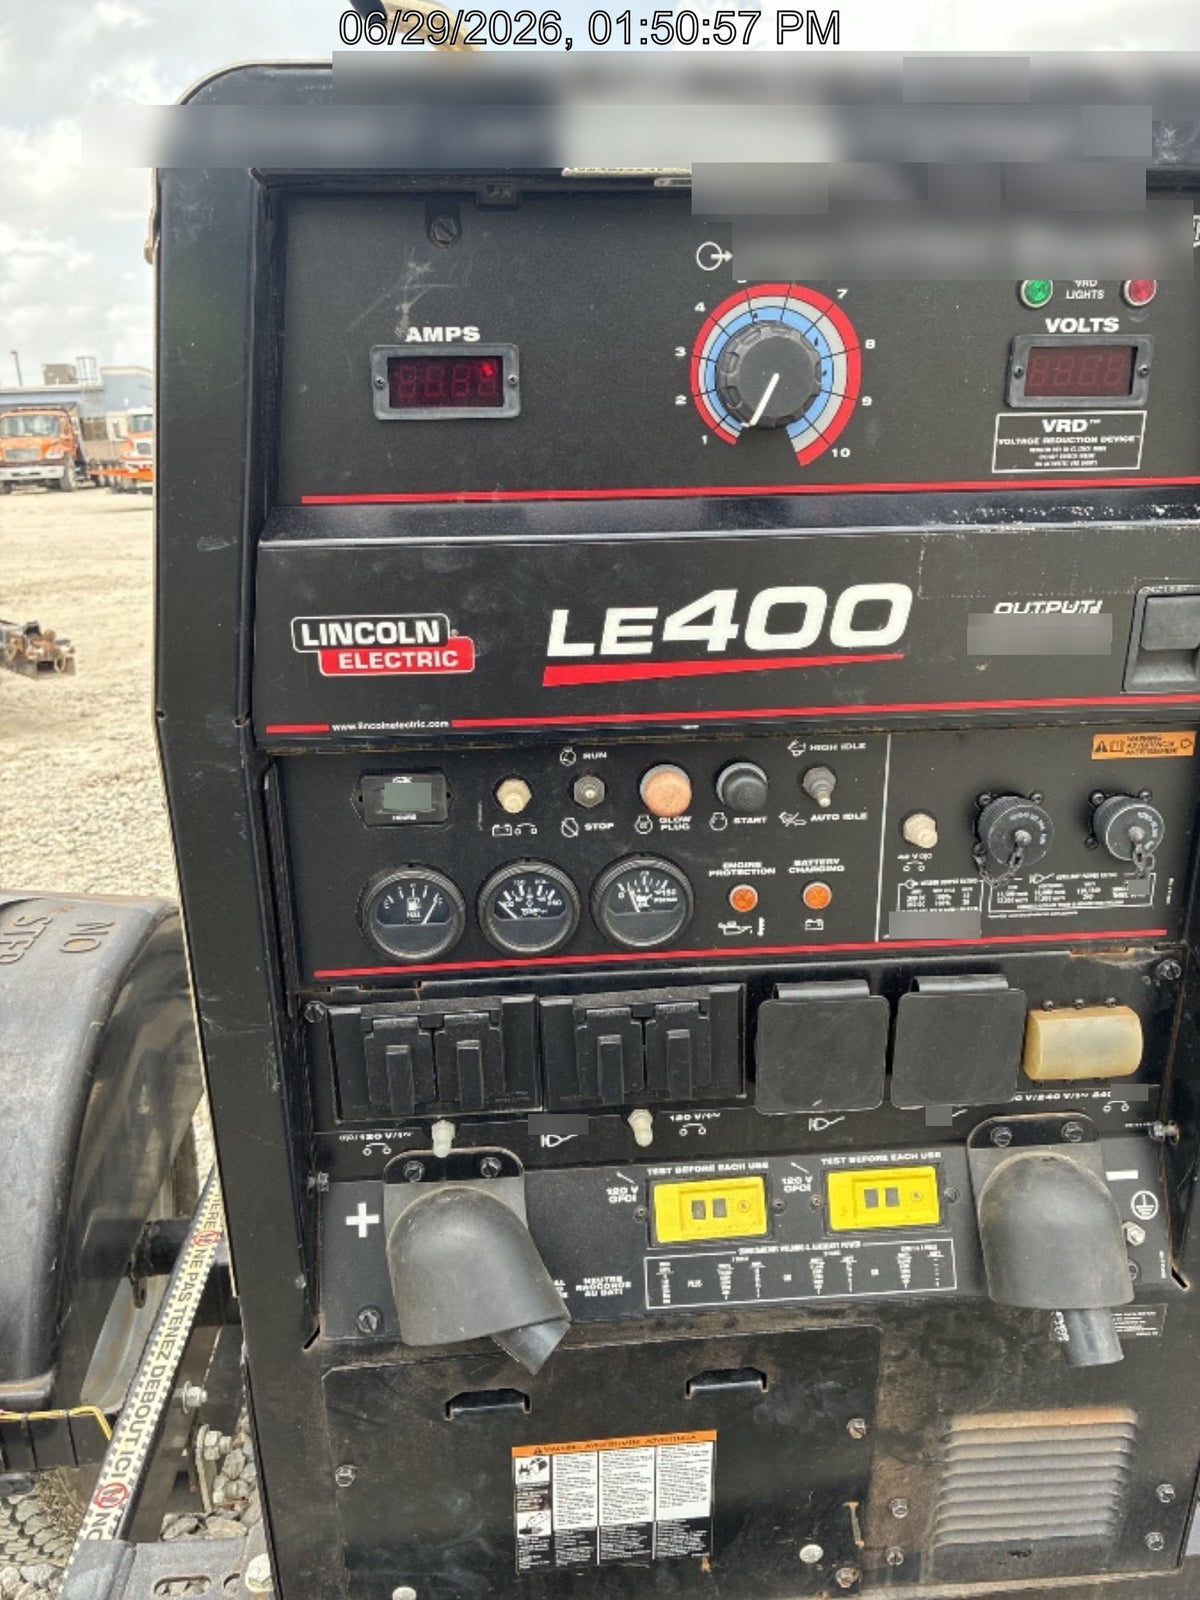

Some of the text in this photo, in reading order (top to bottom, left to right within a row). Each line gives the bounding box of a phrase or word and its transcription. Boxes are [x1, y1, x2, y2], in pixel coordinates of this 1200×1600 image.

[837, 289, 848, 298] 7
[1066, 290, 1105, 300] LIGHTS
[695, 302, 705, 312] 4
[1045, 317, 1120, 333] VOLTS
[405, 326, 480, 342] AMPS
[866, 340, 875, 349] 8
[675, 347, 686, 356] 3
[675, 396, 686, 405] 2
[862, 397, 872, 406] 9
[702, 435, 707, 444] 1
[1042, 436, 1098, 444] REDUCTION
[832, 449, 850, 458] 10
[547, 583, 913, 657] LE400
[301, 620, 440, 646] LINCOLN
[338, 651, 459, 669] ELECTRIC
[332, 721, 449, 731] www.lincolnelectric.com
[810, 743, 837, 751] HIGH
[733, 816, 767, 824] START
[810, 814, 840, 822] AUTO
[709, 868, 776, 877] PROTECTION
[788, 865, 845, 873] CHARGING
[821, 1151, 942, 1165] TEST BEFORE EACH USE
[647, 1161, 769, 1176] TEST BEFORE EACH USE
[805, 1176, 813, 1184] V
[606, 1185, 639, 1195] 120 V
[608, 1194, 637, 1204] GFCI
[190, 1249, 204, 1269] NE
[583, 1276, 623, 1284] NEUTRE
[178, 1273, 198, 1302] PAS
[156, 1306, 188, 1362] TENEZ
[125, 1365, 165, 1446] DEBOUT
[111, 1450, 134, 1478] ICI
